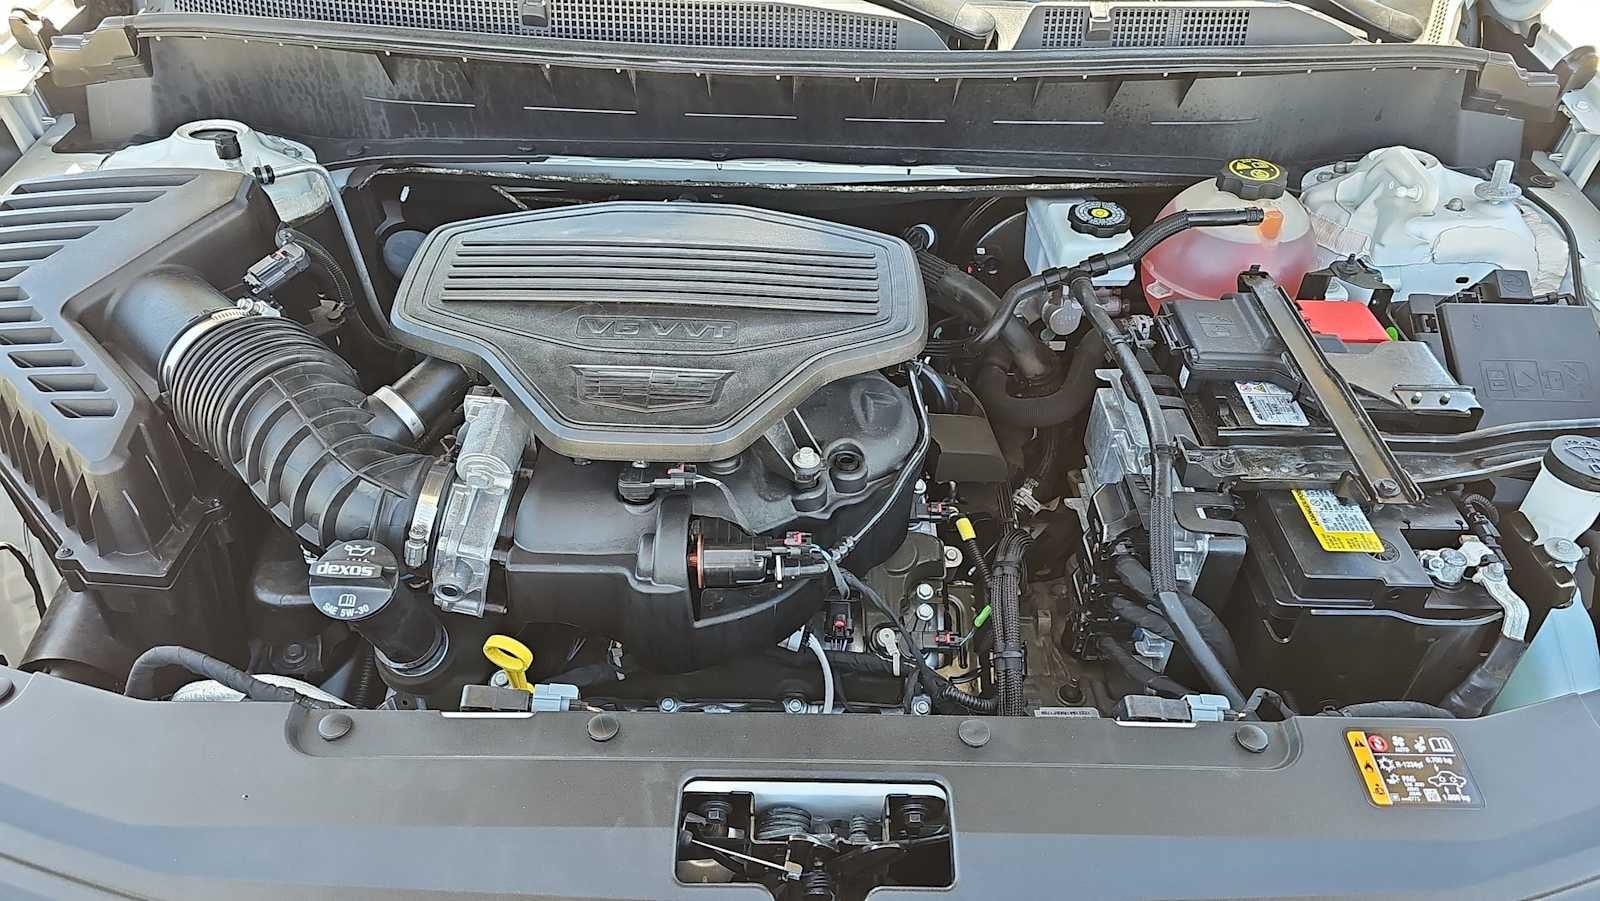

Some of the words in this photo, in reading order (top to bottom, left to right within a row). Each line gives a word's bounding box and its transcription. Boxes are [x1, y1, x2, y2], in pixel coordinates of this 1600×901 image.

[649, 320, 731, 337] VVT
[317, 562, 375, 576] dexos
[323, 603, 338, 615] SAE
[340, 604, 369, 617] 5W-30
